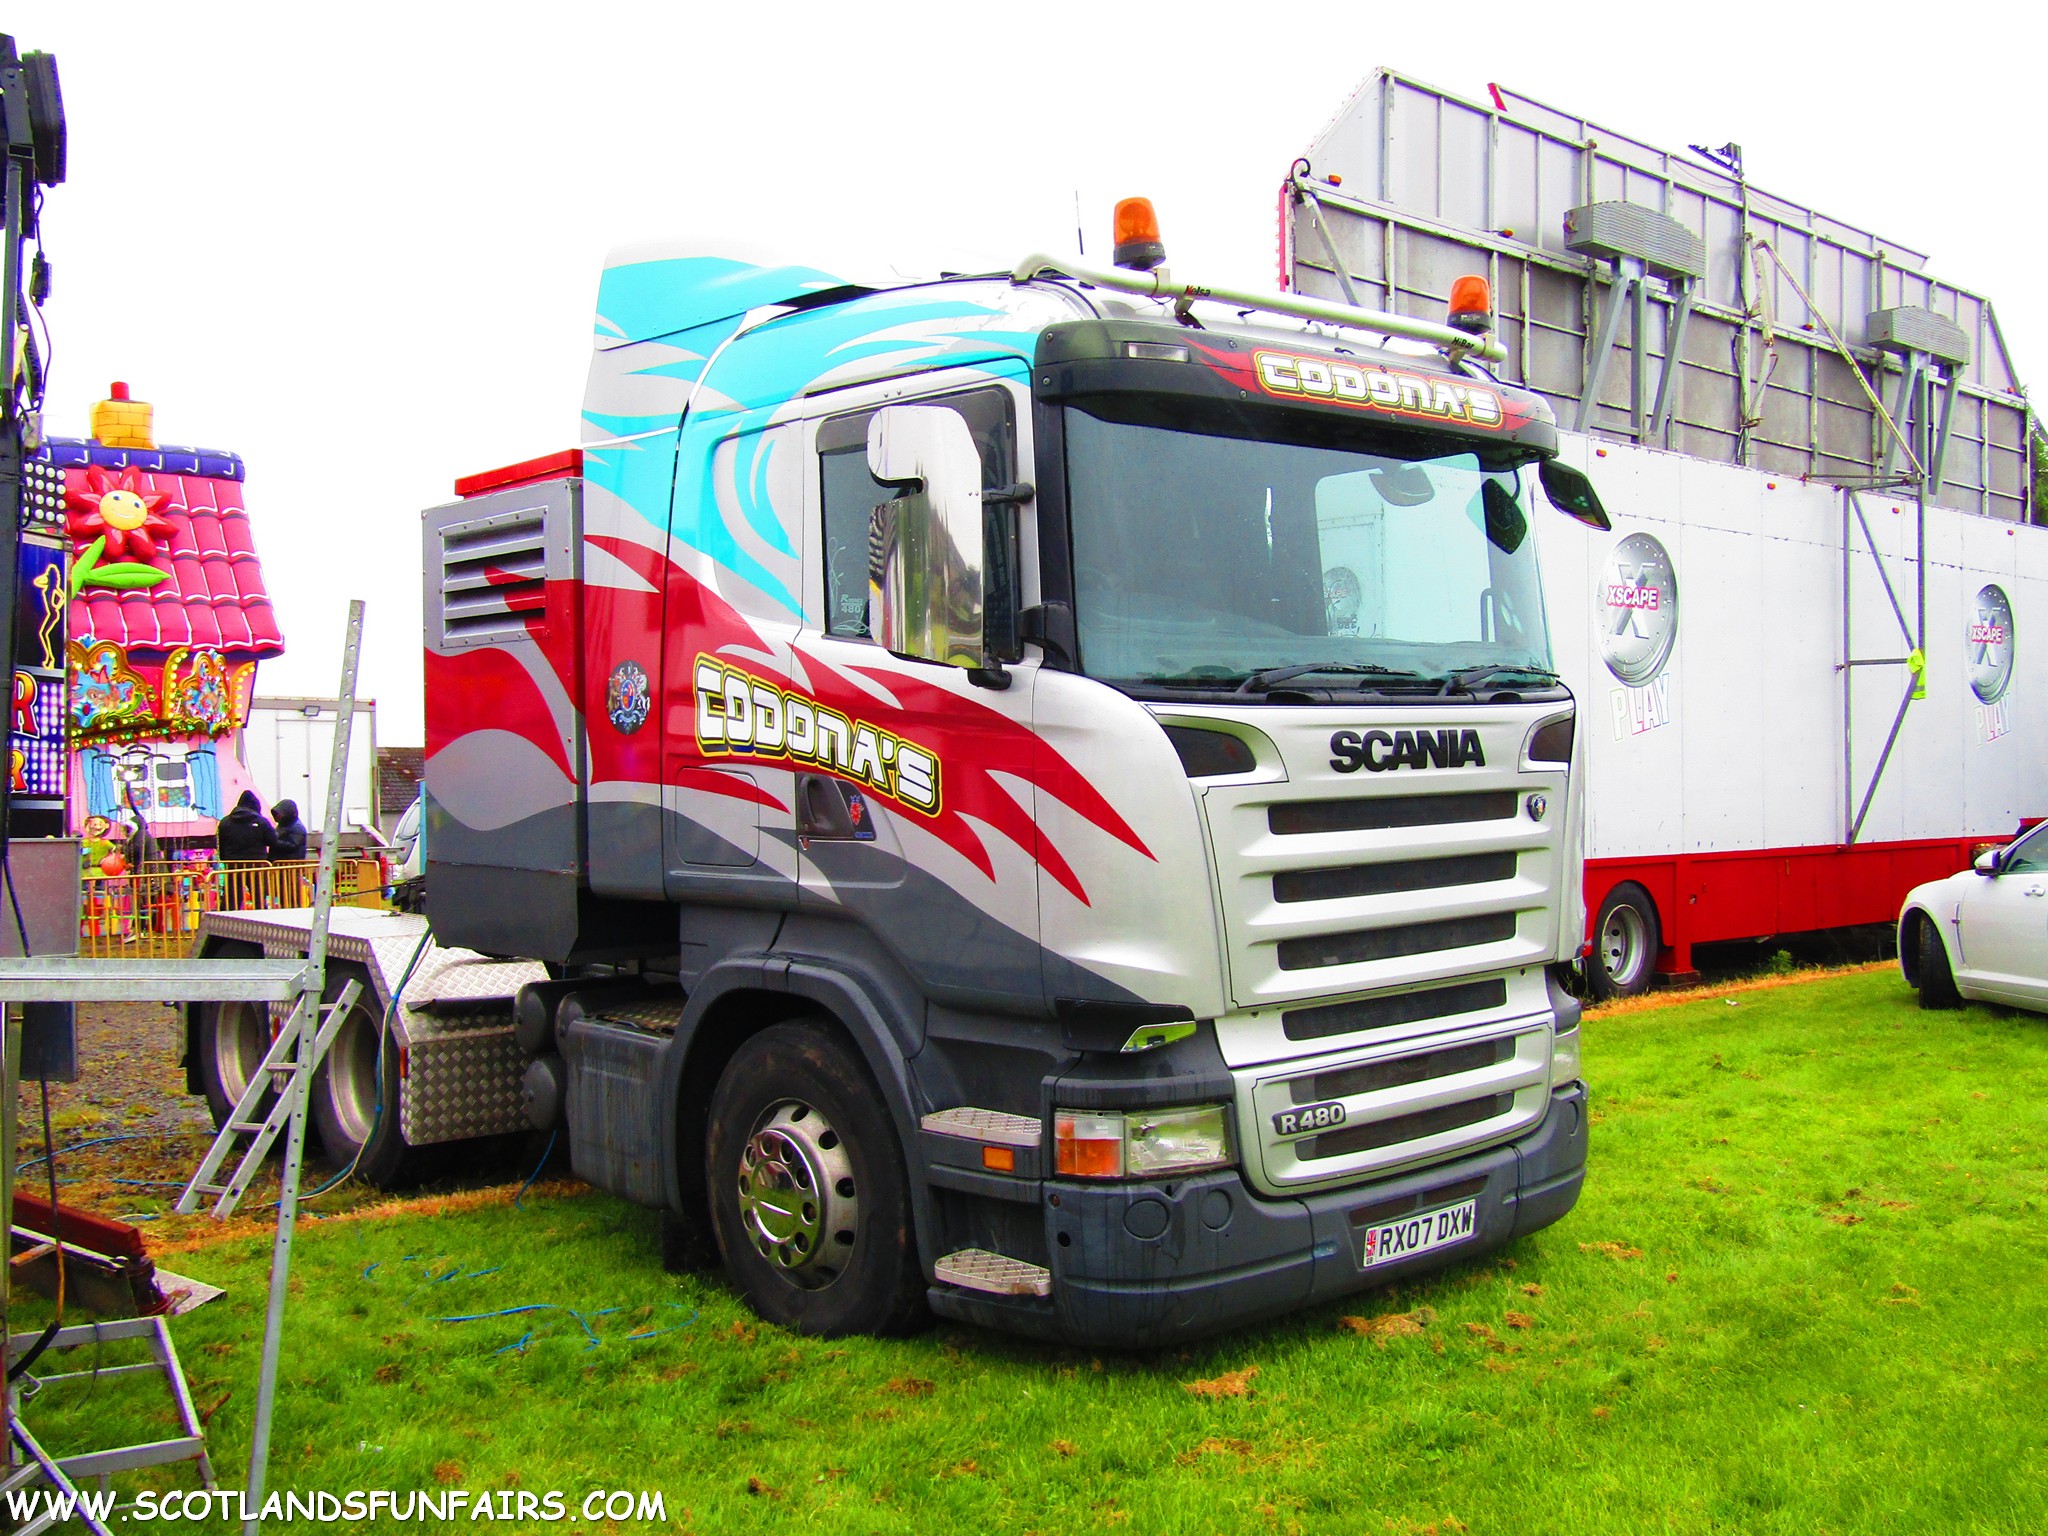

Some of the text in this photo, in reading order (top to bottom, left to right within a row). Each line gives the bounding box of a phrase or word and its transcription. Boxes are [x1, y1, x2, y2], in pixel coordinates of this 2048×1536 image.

[1451, 336, 1475, 349] HiBar
[1257, 353, 1501, 426] CODONA'S
[1607, 586, 1659, 609] XSCAPE
[1972, 626, 2002, 643] XSCAPE
[1610, 673, 1670, 742] PLAY
[694, 654, 941, 816] CODONA'S
[1330, 730, 1485, 773] SCANIA
[1281, 1104, 1344, 1134] R 480
[1379, 1204, 1473, 1257] RX07 DXW
